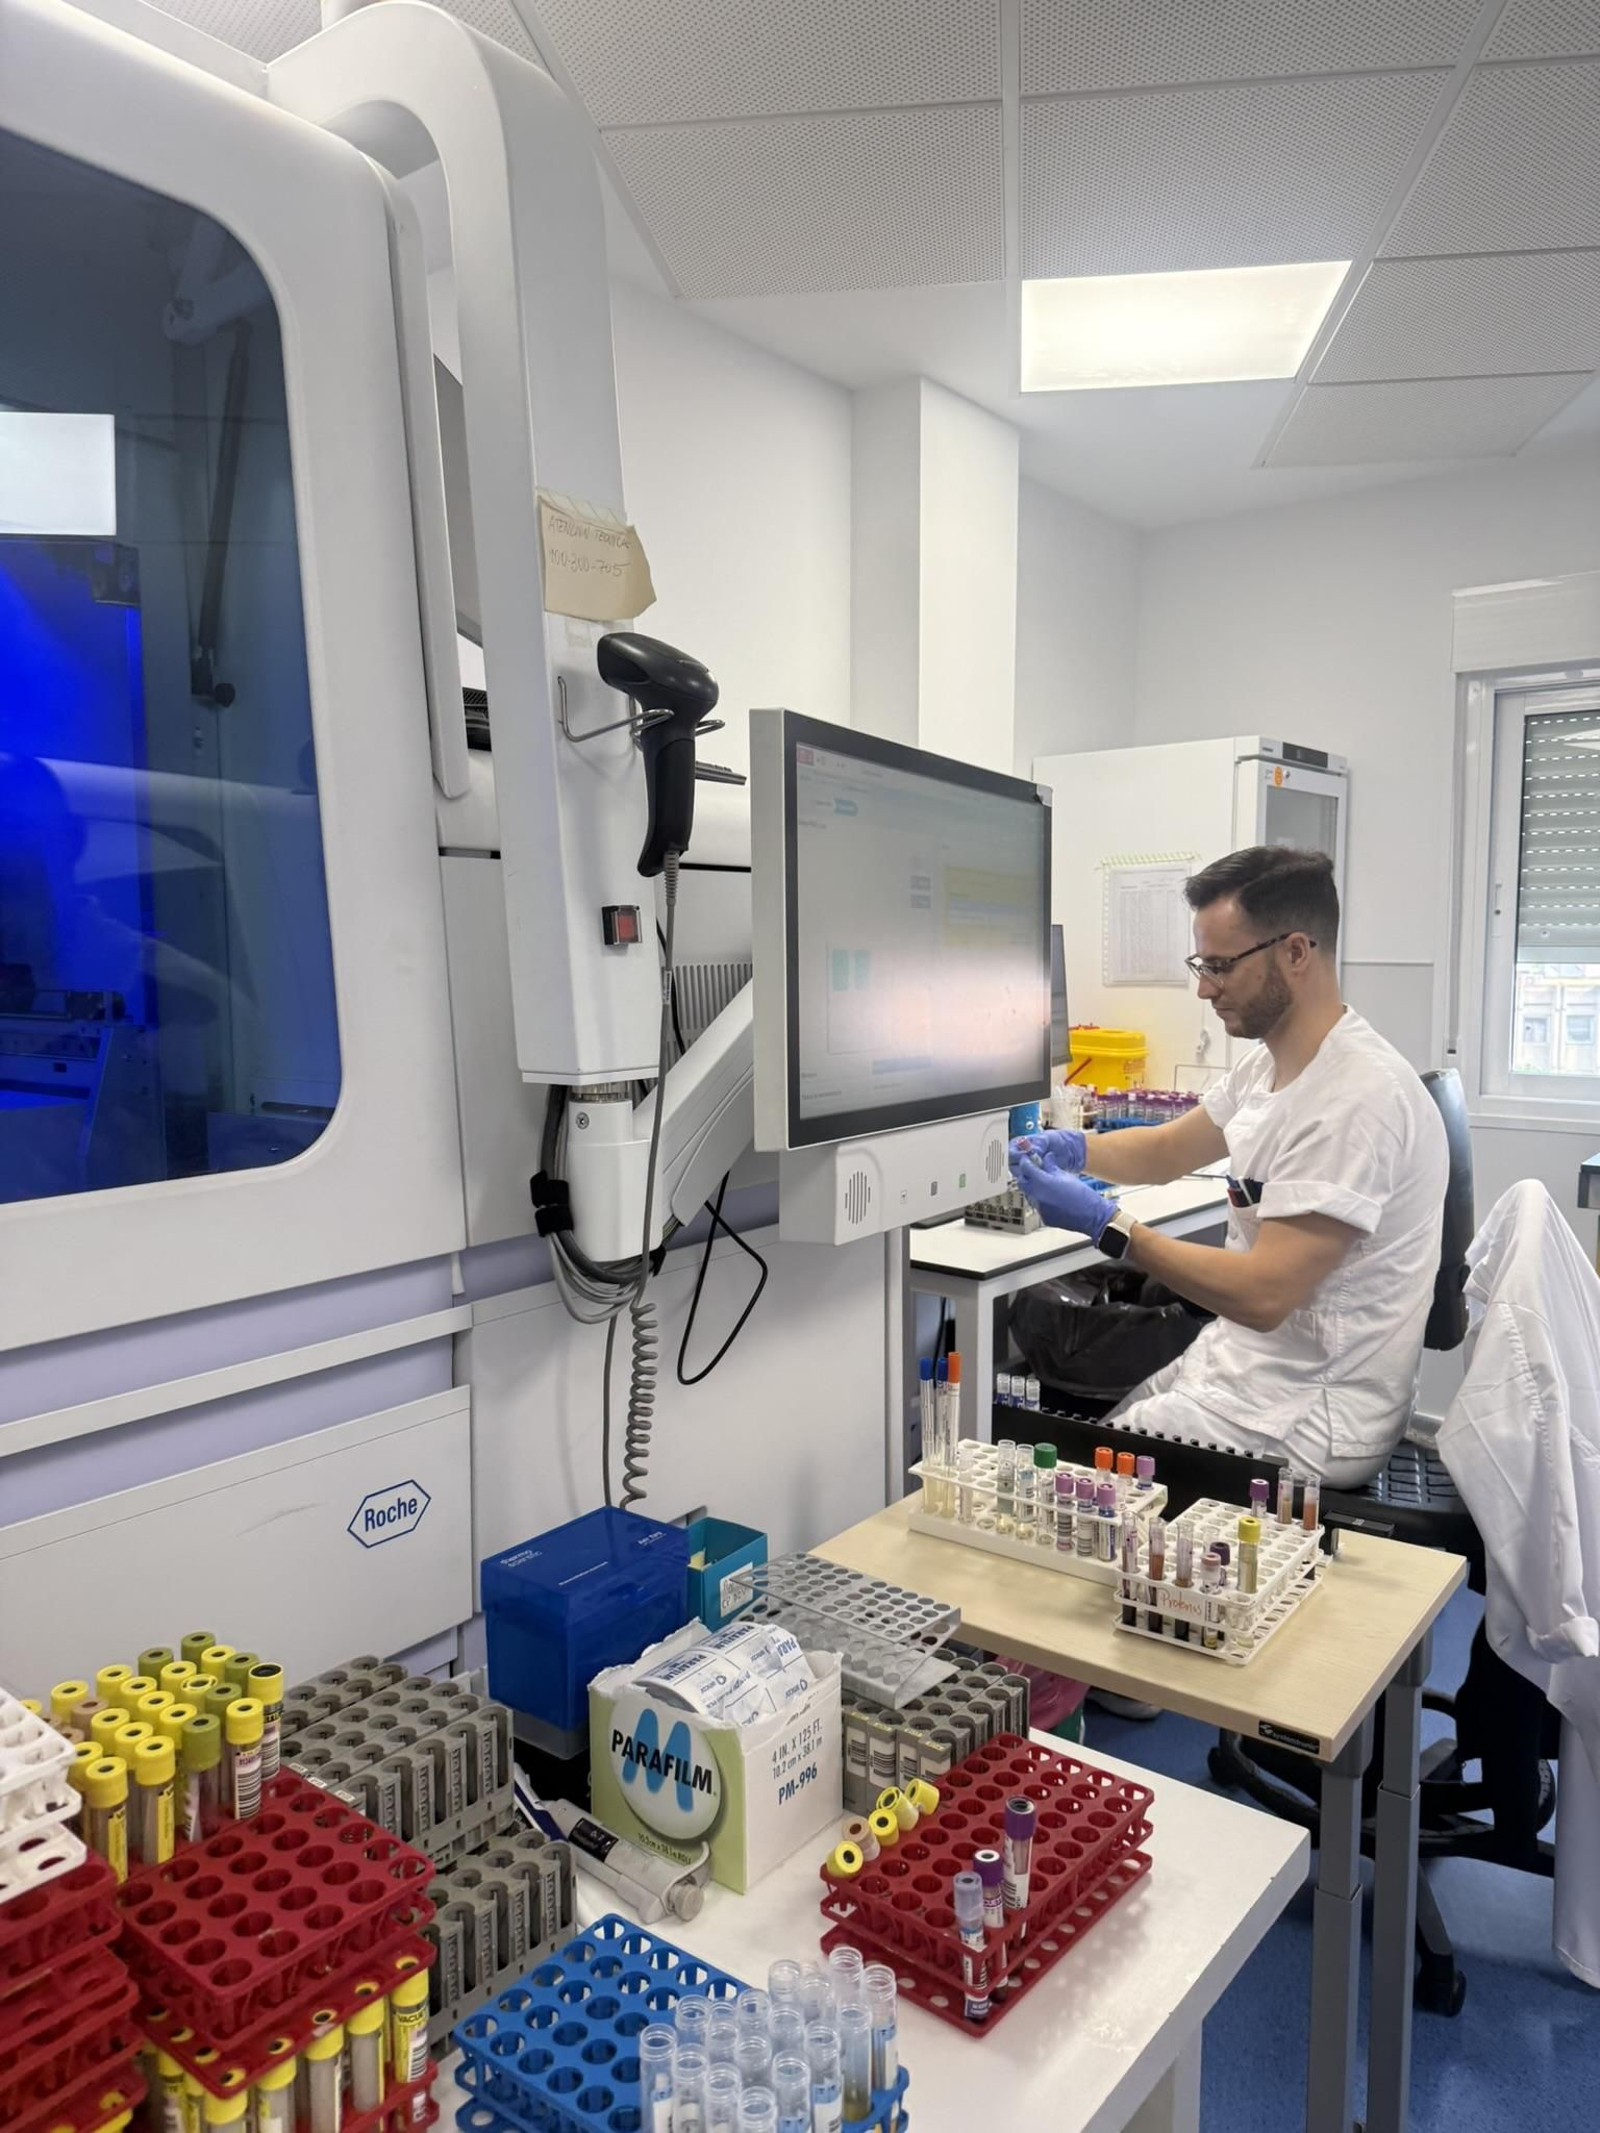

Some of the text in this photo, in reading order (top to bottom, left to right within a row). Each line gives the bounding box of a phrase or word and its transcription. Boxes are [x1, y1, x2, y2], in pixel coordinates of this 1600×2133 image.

[364, 1497, 418, 1532] Roche
[661, 1654, 707, 1681] PARAFILM
[772, 1717, 823, 1764] 4 IN. X 125 FT.
[611, 1729, 713, 1795] PARAFILM
[772, 1759, 787, 1780] 10.2
[787, 1756, 797, 1771] cm
[778, 1761, 818, 1806] PM-996
